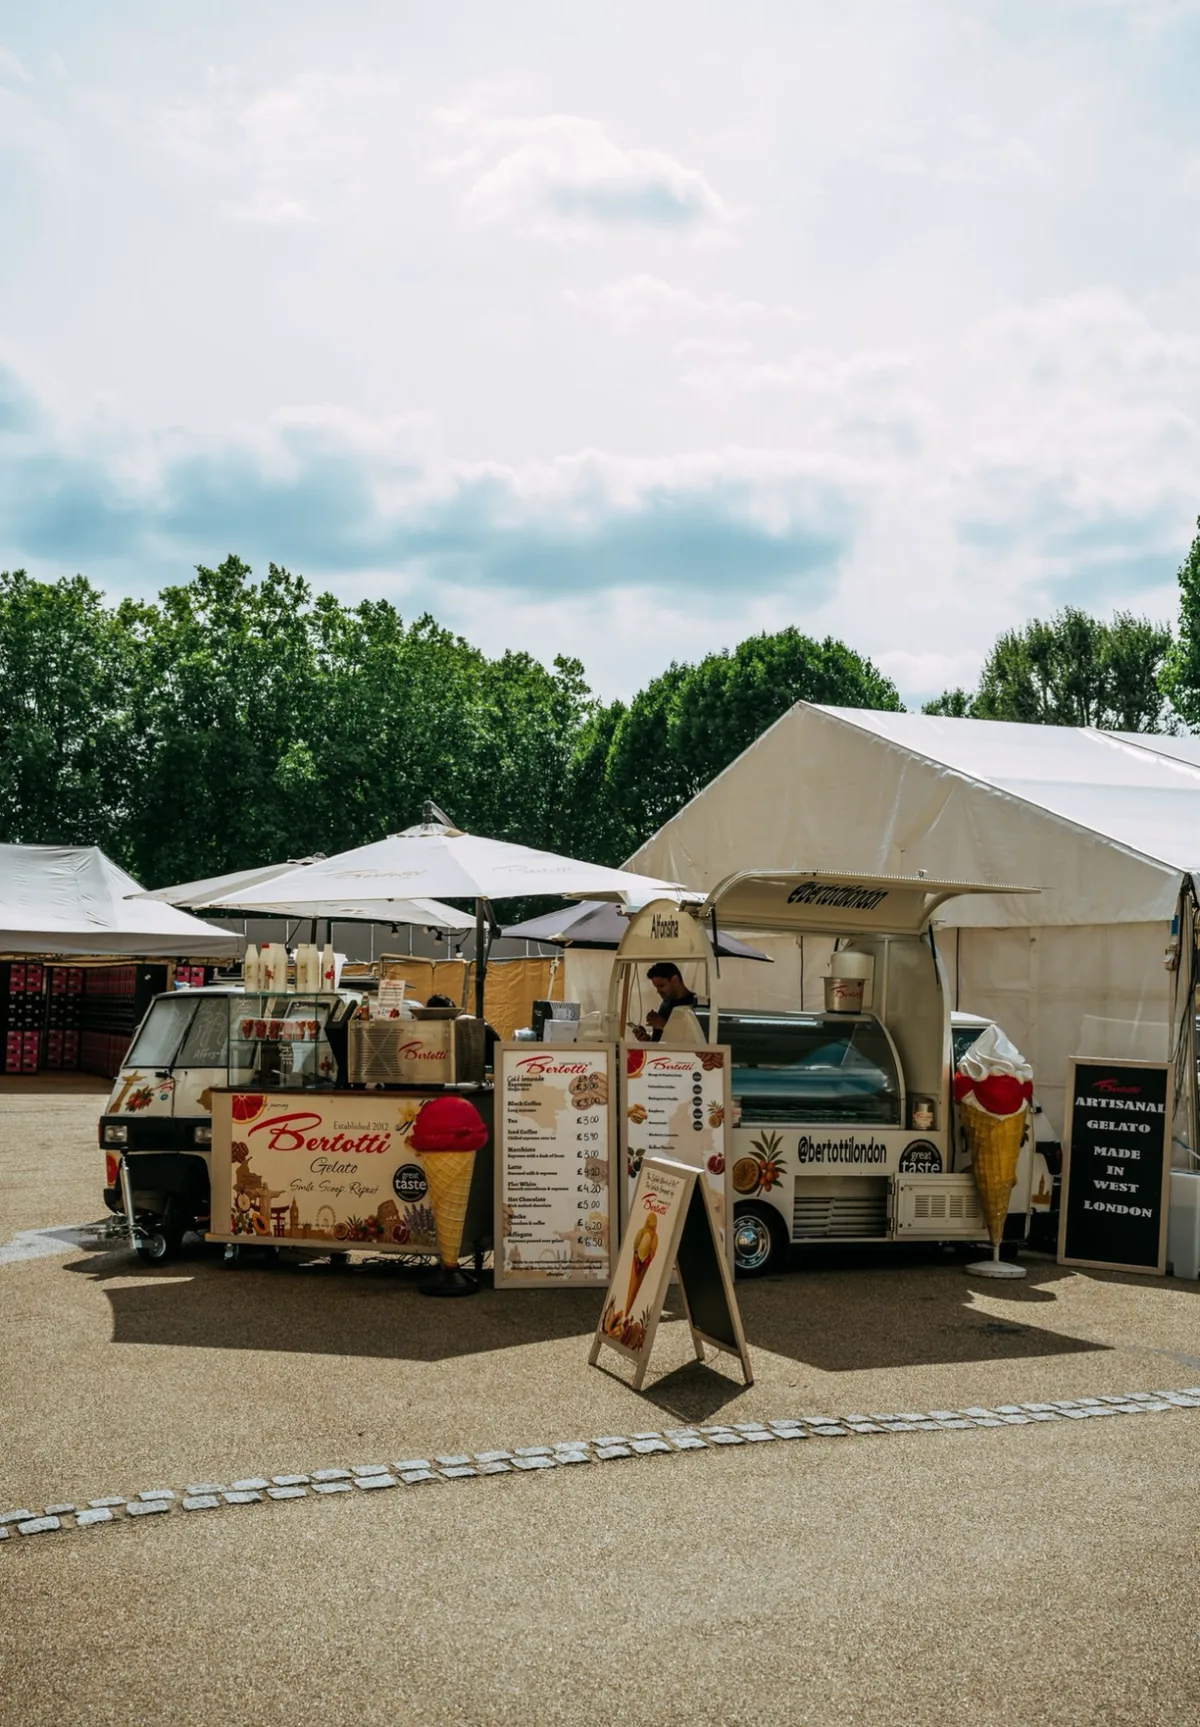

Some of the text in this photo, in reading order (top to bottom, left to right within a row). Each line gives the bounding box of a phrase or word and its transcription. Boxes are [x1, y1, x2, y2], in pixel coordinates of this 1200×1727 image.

[398, 1041, 449, 1060] Bertotti
[515, 1055, 590, 1074] Bertotti
[647, 1057, 693, 1070] Bertotti
[1075, 1096, 1166, 1113] ARTISANAL
[248, 1112, 391, 1154] Bertotti
[333, 1121, 389, 1131] Established 2012
[1087, 1119, 1151, 1133] GELATO
[798, 1136, 887, 1163] @bertottilondon
[911, 1151, 931, 1162] great
[1094, 1145, 1141, 1160] MADE
[310, 1156, 358, 1175] Gelato
[902, 1160, 940, 1173] taste
[1106, 1165, 1124, 1176] IN
[402, 1172, 420, 1181] great
[350, 1181, 379, 1198] Repeat
[395, 1179, 427, 1190] taste
[1093, 1180, 1139, 1193] WEST
[1083, 1200, 1153, 1218] LONDON
